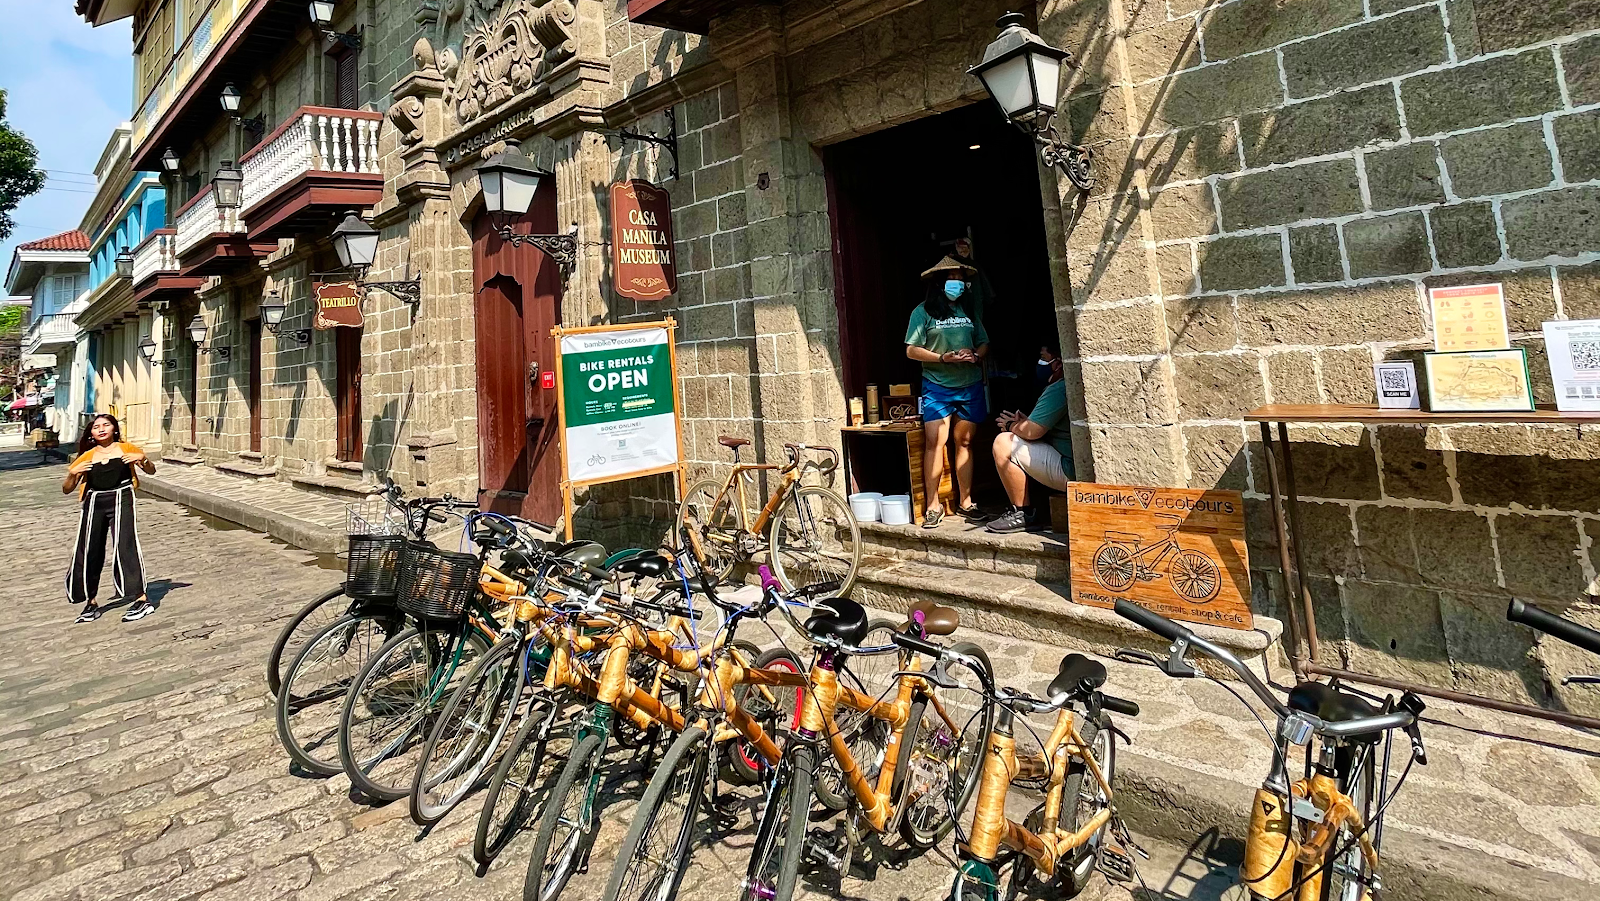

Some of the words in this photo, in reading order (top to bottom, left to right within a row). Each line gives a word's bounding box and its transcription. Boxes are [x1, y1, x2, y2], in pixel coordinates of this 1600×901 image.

[460, 132, 489, 156] CASA
[629, 209, 657, 226] CASA
[622, 229, 667, 245] MANILA
[620, 249, 671, 265] MUSEUM
[320, 297, 357, 308] TEATRILLO
[584, 340, 611, 348] bambike
[617, 337, 646, 345] ecotours
[579, 361, 605, 372] BIKE
[608, 355, 654, 369] RENTALS
[588, 368, 648, 393] OPEN
[1075, 489, 1136, 506] bambike
[1155, 496, 1234, 513] ecotours
[1079, 591, 1110, 603] bamboo
[1191, 608, 1213, 620] shop
[1215, 610, 1222, 620] &
